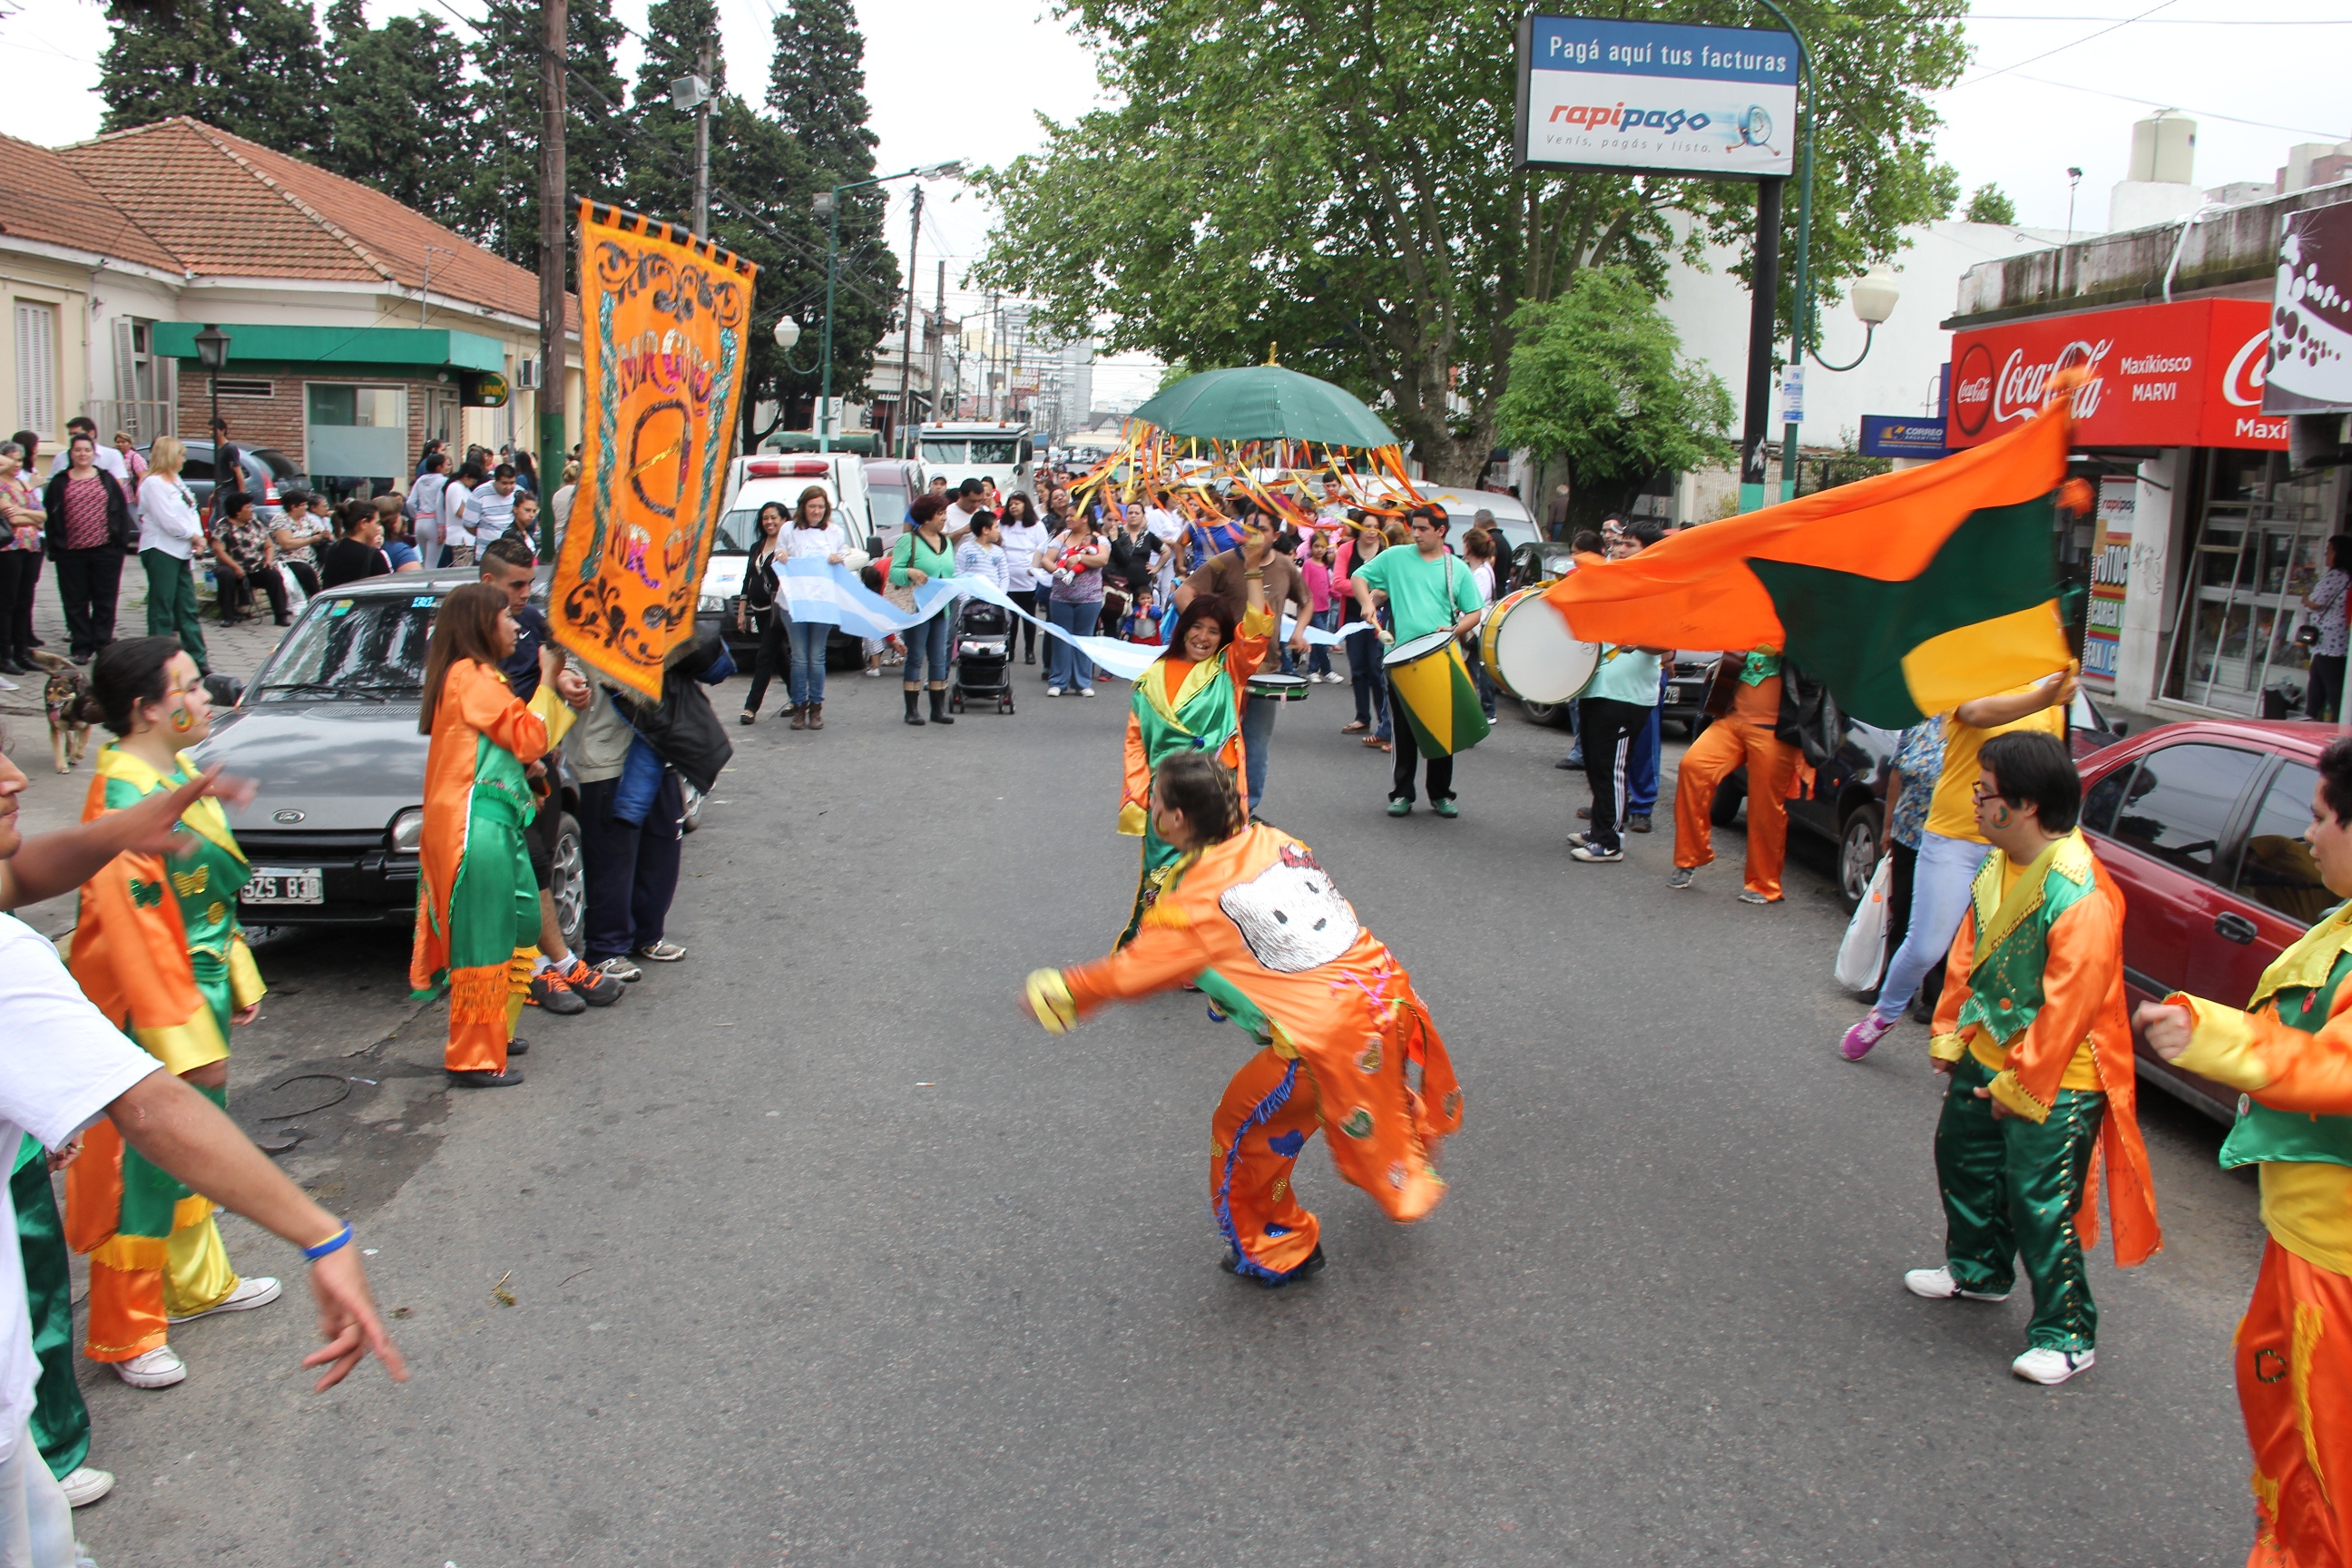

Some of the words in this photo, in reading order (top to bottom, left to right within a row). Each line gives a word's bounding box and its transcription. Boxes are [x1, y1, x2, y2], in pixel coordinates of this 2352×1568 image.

[1550, 35, 1600, 64] Pagá
[1609, 42, 1652, 66] aquí
[1661, 45, 1693, 66] tus
[1701, 45, 1787, 73] facturas
[1548, 102, 1712, 135] rapipago
[1601, 138, 1648, 151] pagás
[1656, 142, 1664, 152] y
[2120, 353, 2191, 375] Maxikiosco
[2132, 381, 2177, 403] MARVI
[1905, 426, 1944, 436] CORREO
[2235, 417, 2288, 440] Maxi
